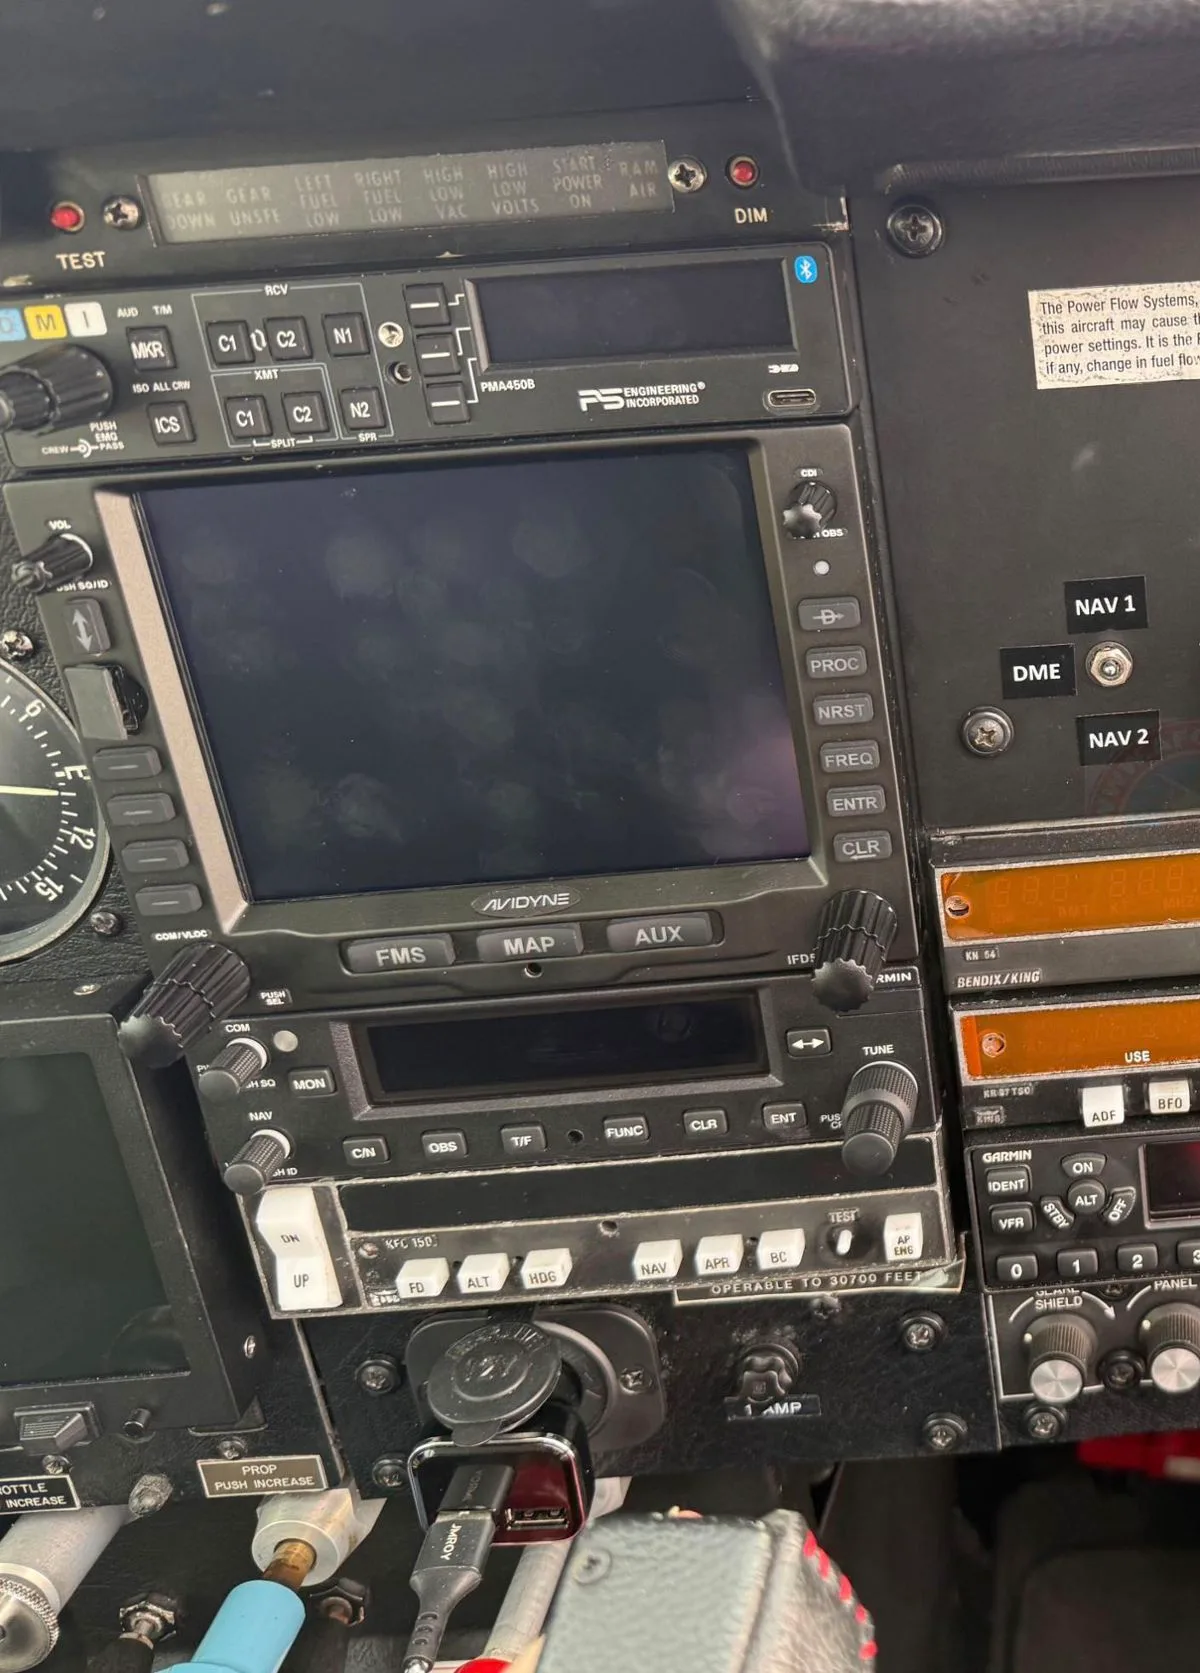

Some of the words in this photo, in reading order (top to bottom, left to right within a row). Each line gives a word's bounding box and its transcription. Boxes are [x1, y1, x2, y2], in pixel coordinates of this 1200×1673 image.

[553, 156, 596, 173] START
[553, 174, 602, 192] POWER
[492, 198, 539, 215] VOLTS
[570, 193, 591, 209] ON
[734, 207, 768, 225] DIM
[56, 252, 106, 271] TEST
[265, 284, 288, 296] RCV
[152, 305, 173, 315] T/M
[1040, 301, 1063, 315] The
[1067, 299, 1105, 313] Power
[1110, 297, 1139, 311] Flow
[1143, 294, 1198, 312] Systems,
[117, 308, 138, 318] AUD
[35, 313, 57, 331] M
[1042, 321, 1065, 335] this
[1071, 318, 1114, 333] aircraft
[1120, 317, 1146, 331] may
[1152, 315, 1187, 328] cause
[219, 334, 237, 352] C1
[276, 330, 297, 347] C2
[334, 328, 353, 344] N1
[131, 341, 165, 360] MKR
[254, 369, 279, 380] XMT
[480, 378, 536, 393] PMA450B
[625, 394, 700, 408] INCORPORATED
[236, 408, 255, 427] C1
[293, 405, 313, 424] C2
[350, 401, 371, 418] N2
[90, 422, 117, 432] PUSH
[155, 416, 180, 433] ICS
[271, 438, 295, 449] SPLIT
[358, 431, 378, 443] SPR
[42, 446, 68, 455] CREW
[100, 441, 124, 451] PASS
[48, 520, 72, 530] VOL
[811, 658, 860, 674] PROC
[1013, 663, 1061, 682] DME
[819, 704, 864, 720] NRST
[825, 752, 873, 769] FREQ
[833, 796, 878, 811] ENTR
[842, 840, 881, 856] CLR
[483, 892, 570, 911] AVIDYNE
[635, 925, 684, 946] AUX
[503, 936, 555, 956] MAP
[376, 947, 427, 967] FMS
[957, 970, 1041, 988] BENDIX/KING
[225, 1023, 251, 1033] COM
[862, 1044, 894, 1056] TUNE
[1124, 1050, 1151, 1063] USE
[294, 1077, 326, 1091] MON
[1158, 1097, 1183, 1110] BFO
[249, 1111, 273, 1121] NAV
[771, 1112, 797, 1126] ENT
[1092, 1111, 1117, 1123] ADF
[607, 1124, 643, 1139] FUNC
[691, 1118, 718, 1131] CLR
[428, 1140, 458, 1153] OBS
[511, 1135, 532, 1147] T/F
[352, 1146, 376, 1160] C/N
[982, 1150, 1032, 1163] GARMIN
[1072, 1162, 1093, 1174] ON
[988, 1179, 1025, 1192] IDENT
[1075, 1195, 1098, 1206] ALT
[829, 1209, 858, 1222] TEST
[1000, 1217, 1025, 1229] VFR
[641, 1263, 667, 1276] NAV
[705, 1258, 730, 1271] APR
[468, 1277, 490, 1289] ALT
[529, 1271, 557, 1285] HDG
[1154, 1278, 1198, 1291] PANEL
[1035, 1296, 1083, 1310] SHIELD
[242, 1463, 278, 1476] PROP
[215, 1478, 249, 1491] PUSH
[253, 1475, 315, 1490] INCREASE
